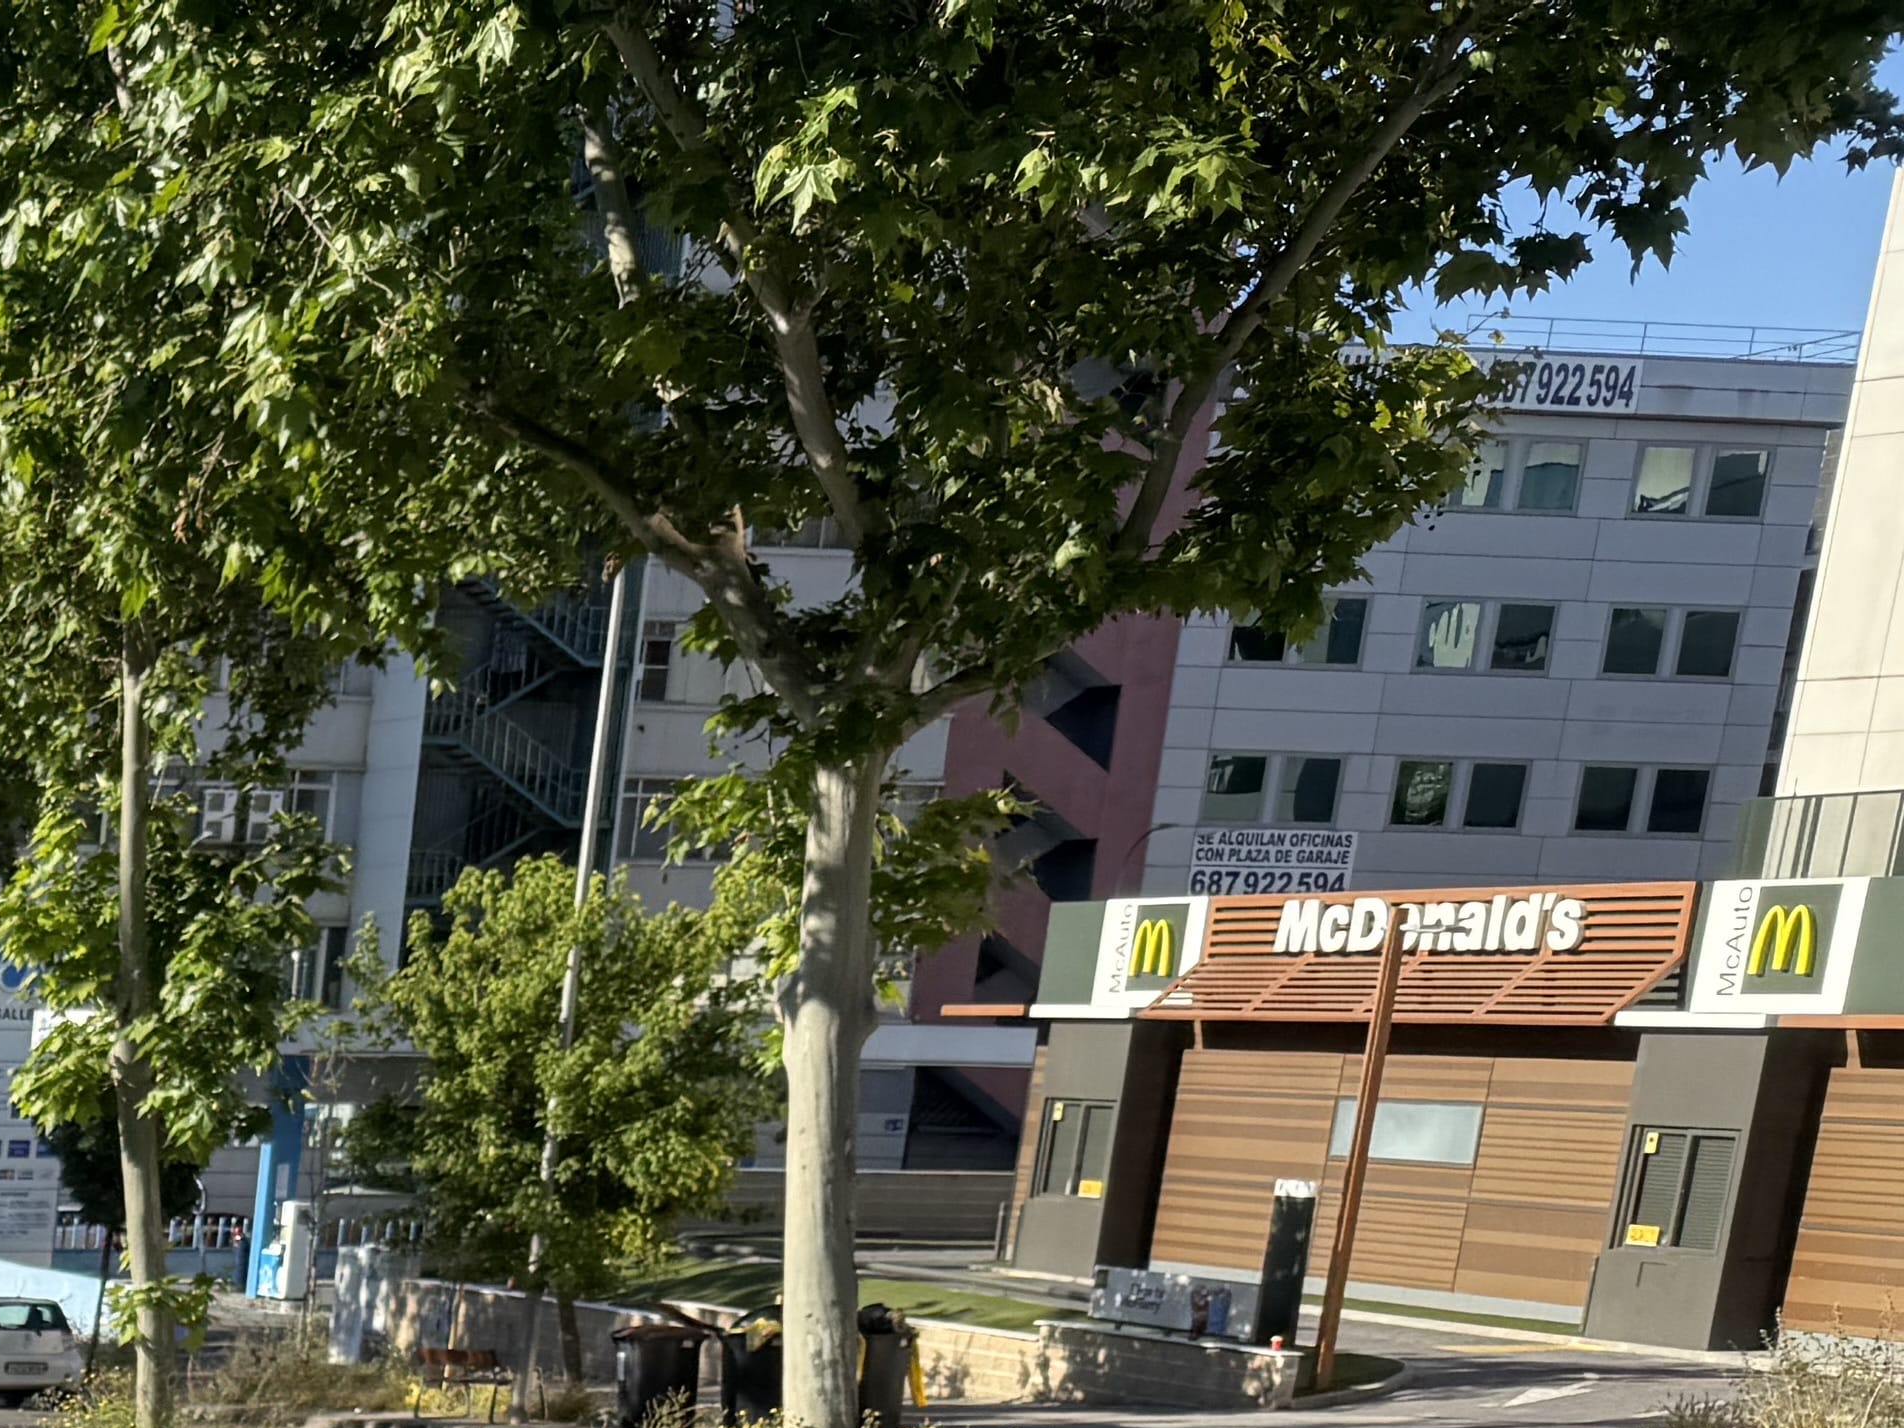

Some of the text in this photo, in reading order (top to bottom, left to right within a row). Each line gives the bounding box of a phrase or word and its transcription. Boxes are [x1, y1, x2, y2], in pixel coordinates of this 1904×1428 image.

[1195, 848, 1352, 865] CON PLAZA DE GARAJE
[1196, 832, 1354, 848] SE ALQUILAN OFICINAS
[1108, 903, 1133, 994] McAuto
[1715, 886, 1754, 996] McAuto
